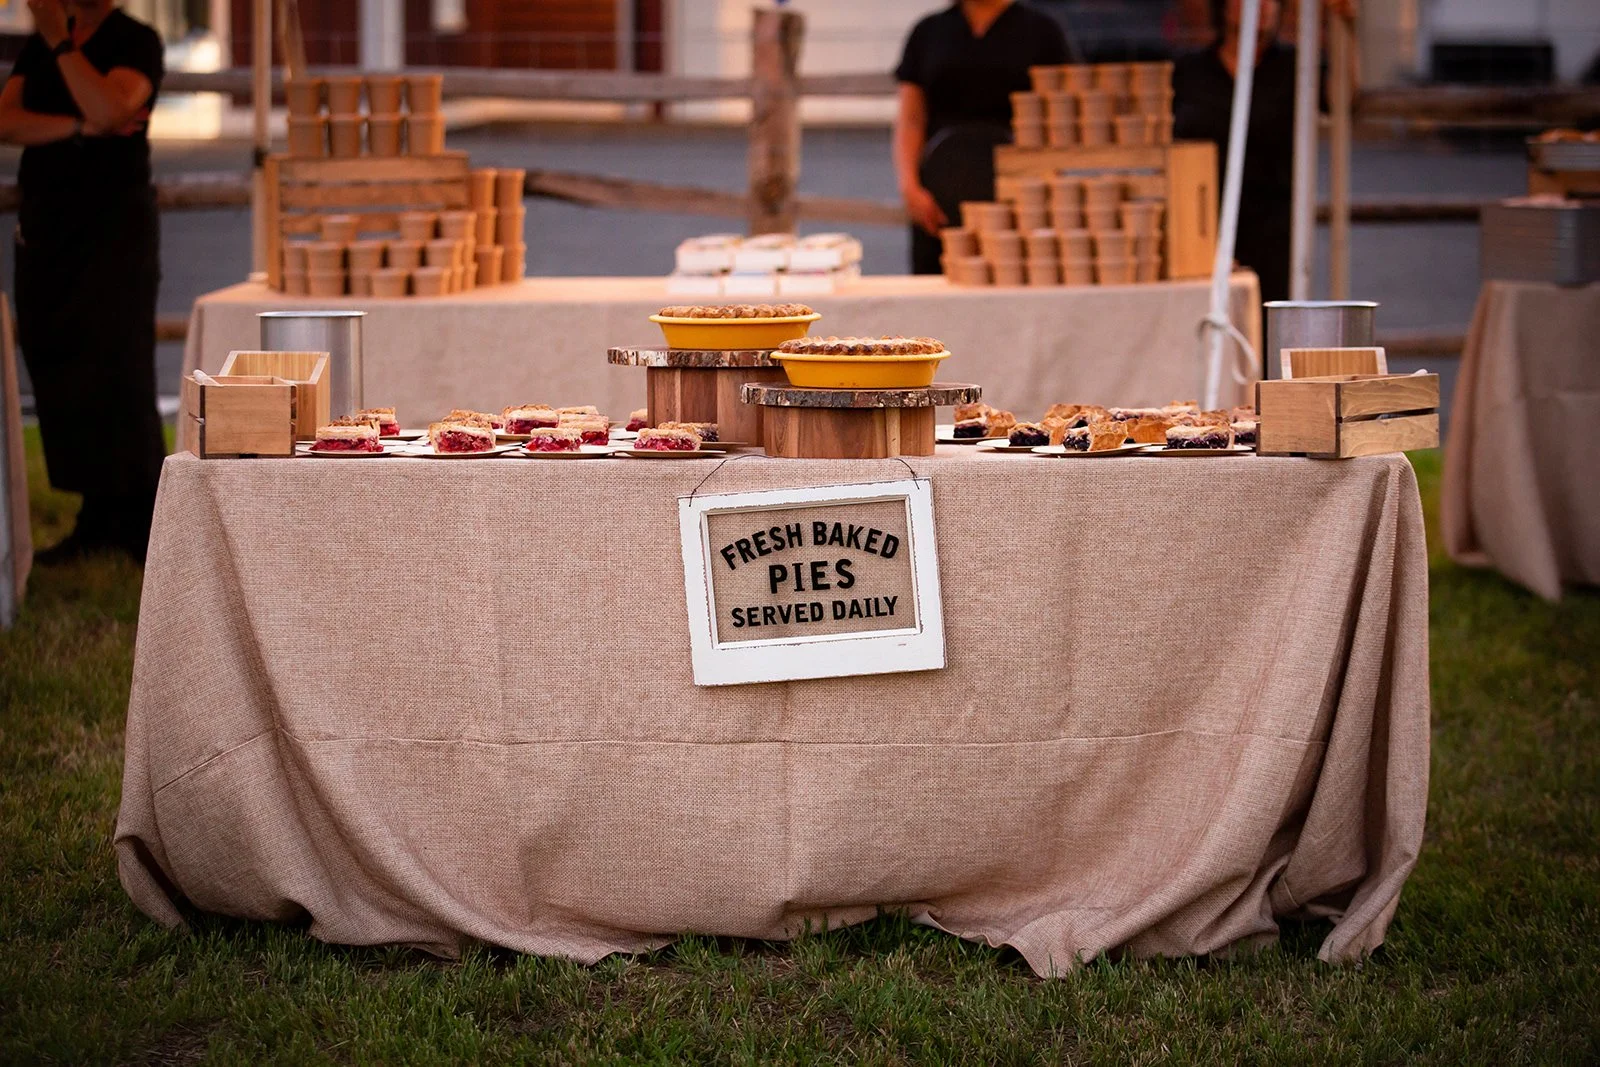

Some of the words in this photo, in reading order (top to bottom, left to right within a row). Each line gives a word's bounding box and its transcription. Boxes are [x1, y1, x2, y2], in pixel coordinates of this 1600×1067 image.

[720, 522, 802, 570] FRESH
[812, 521, 900, 559] BAKED
[769, 558, 856, 594] PIES
[731, 602, 824, 628] SERVED
[832, 595, 898, 620] DAILY
